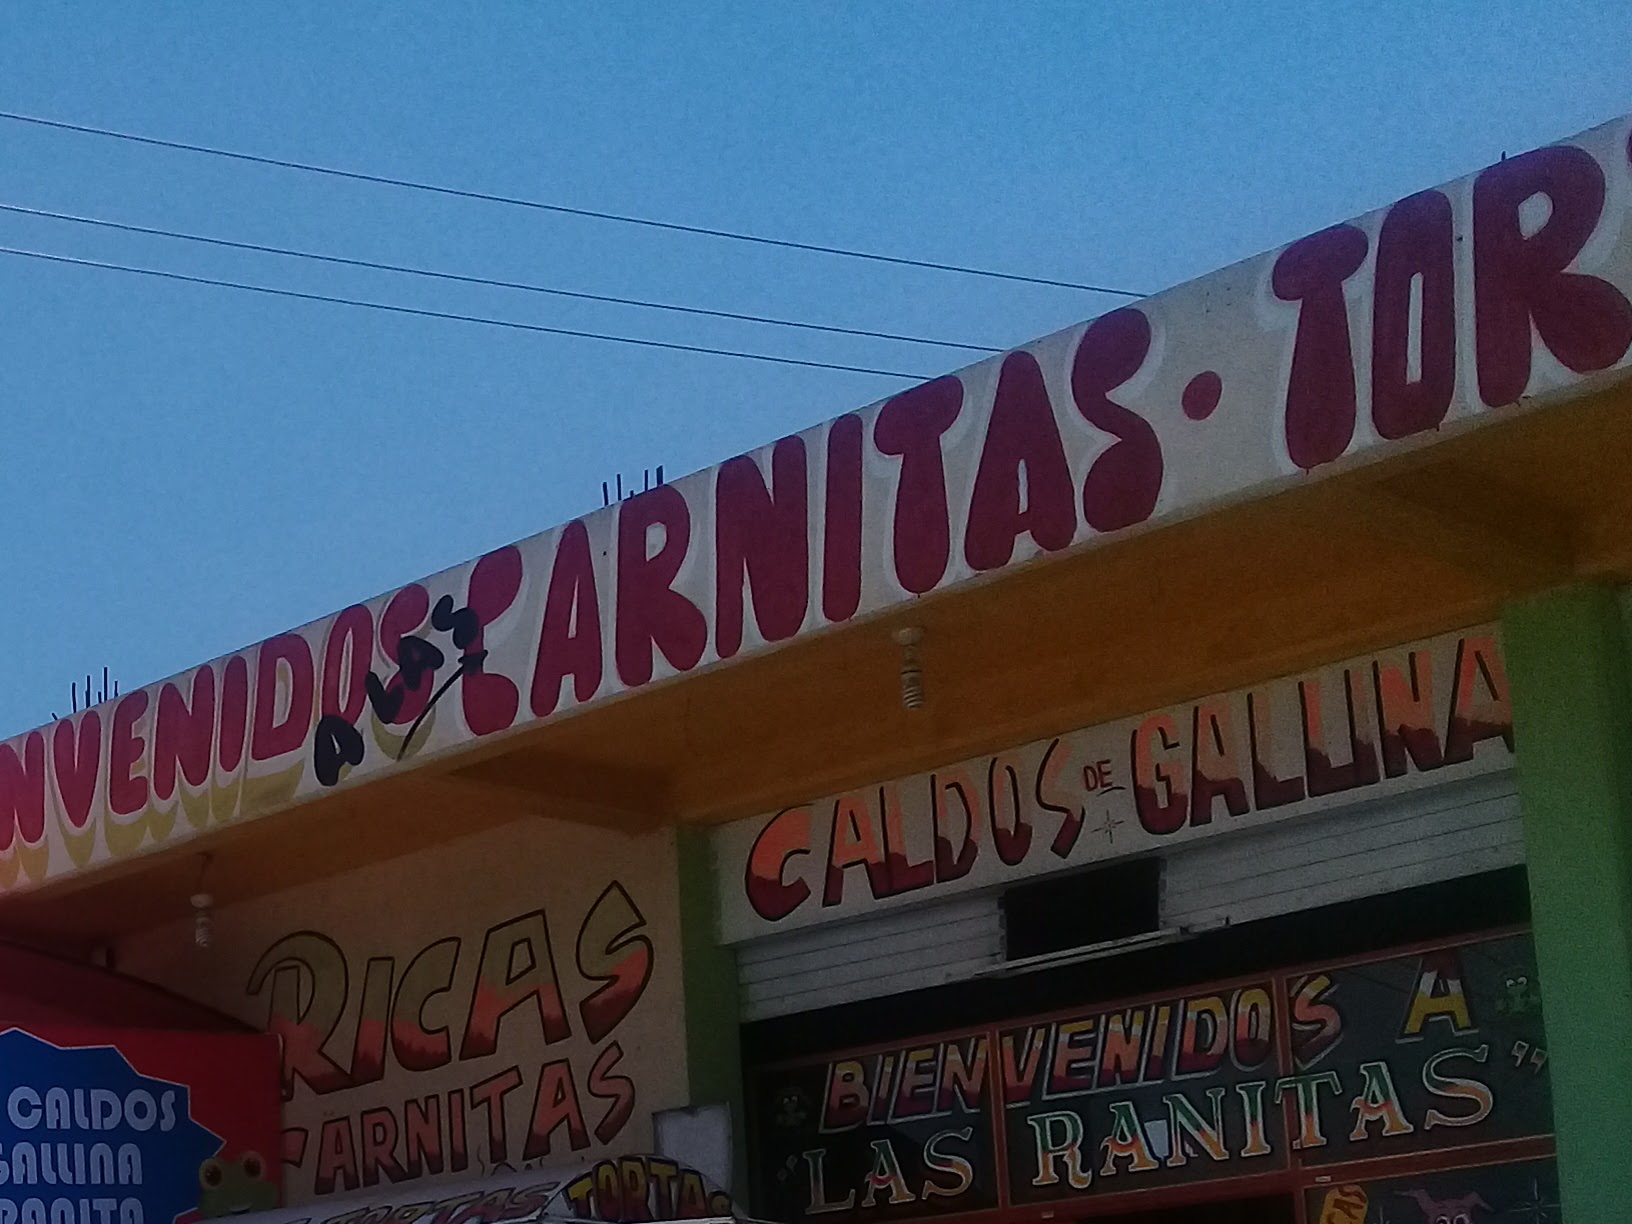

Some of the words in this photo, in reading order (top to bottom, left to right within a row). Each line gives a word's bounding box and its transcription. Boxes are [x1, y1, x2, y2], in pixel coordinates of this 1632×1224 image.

[461, 306, 1165, 736] CARNITAS
[745, 737, 1086, 922] CALDOS
[1083, 757, 1120, 793] DE
[1130, 637, 1516, 836] GALLINA
[246, 879, 656, 1099] RICAS
[818, 974, 1344, 1134] BIENVENIDOS
[1395, 957, 1479, 1044] A
[6, 1087, 177, 1132] CALDOS
